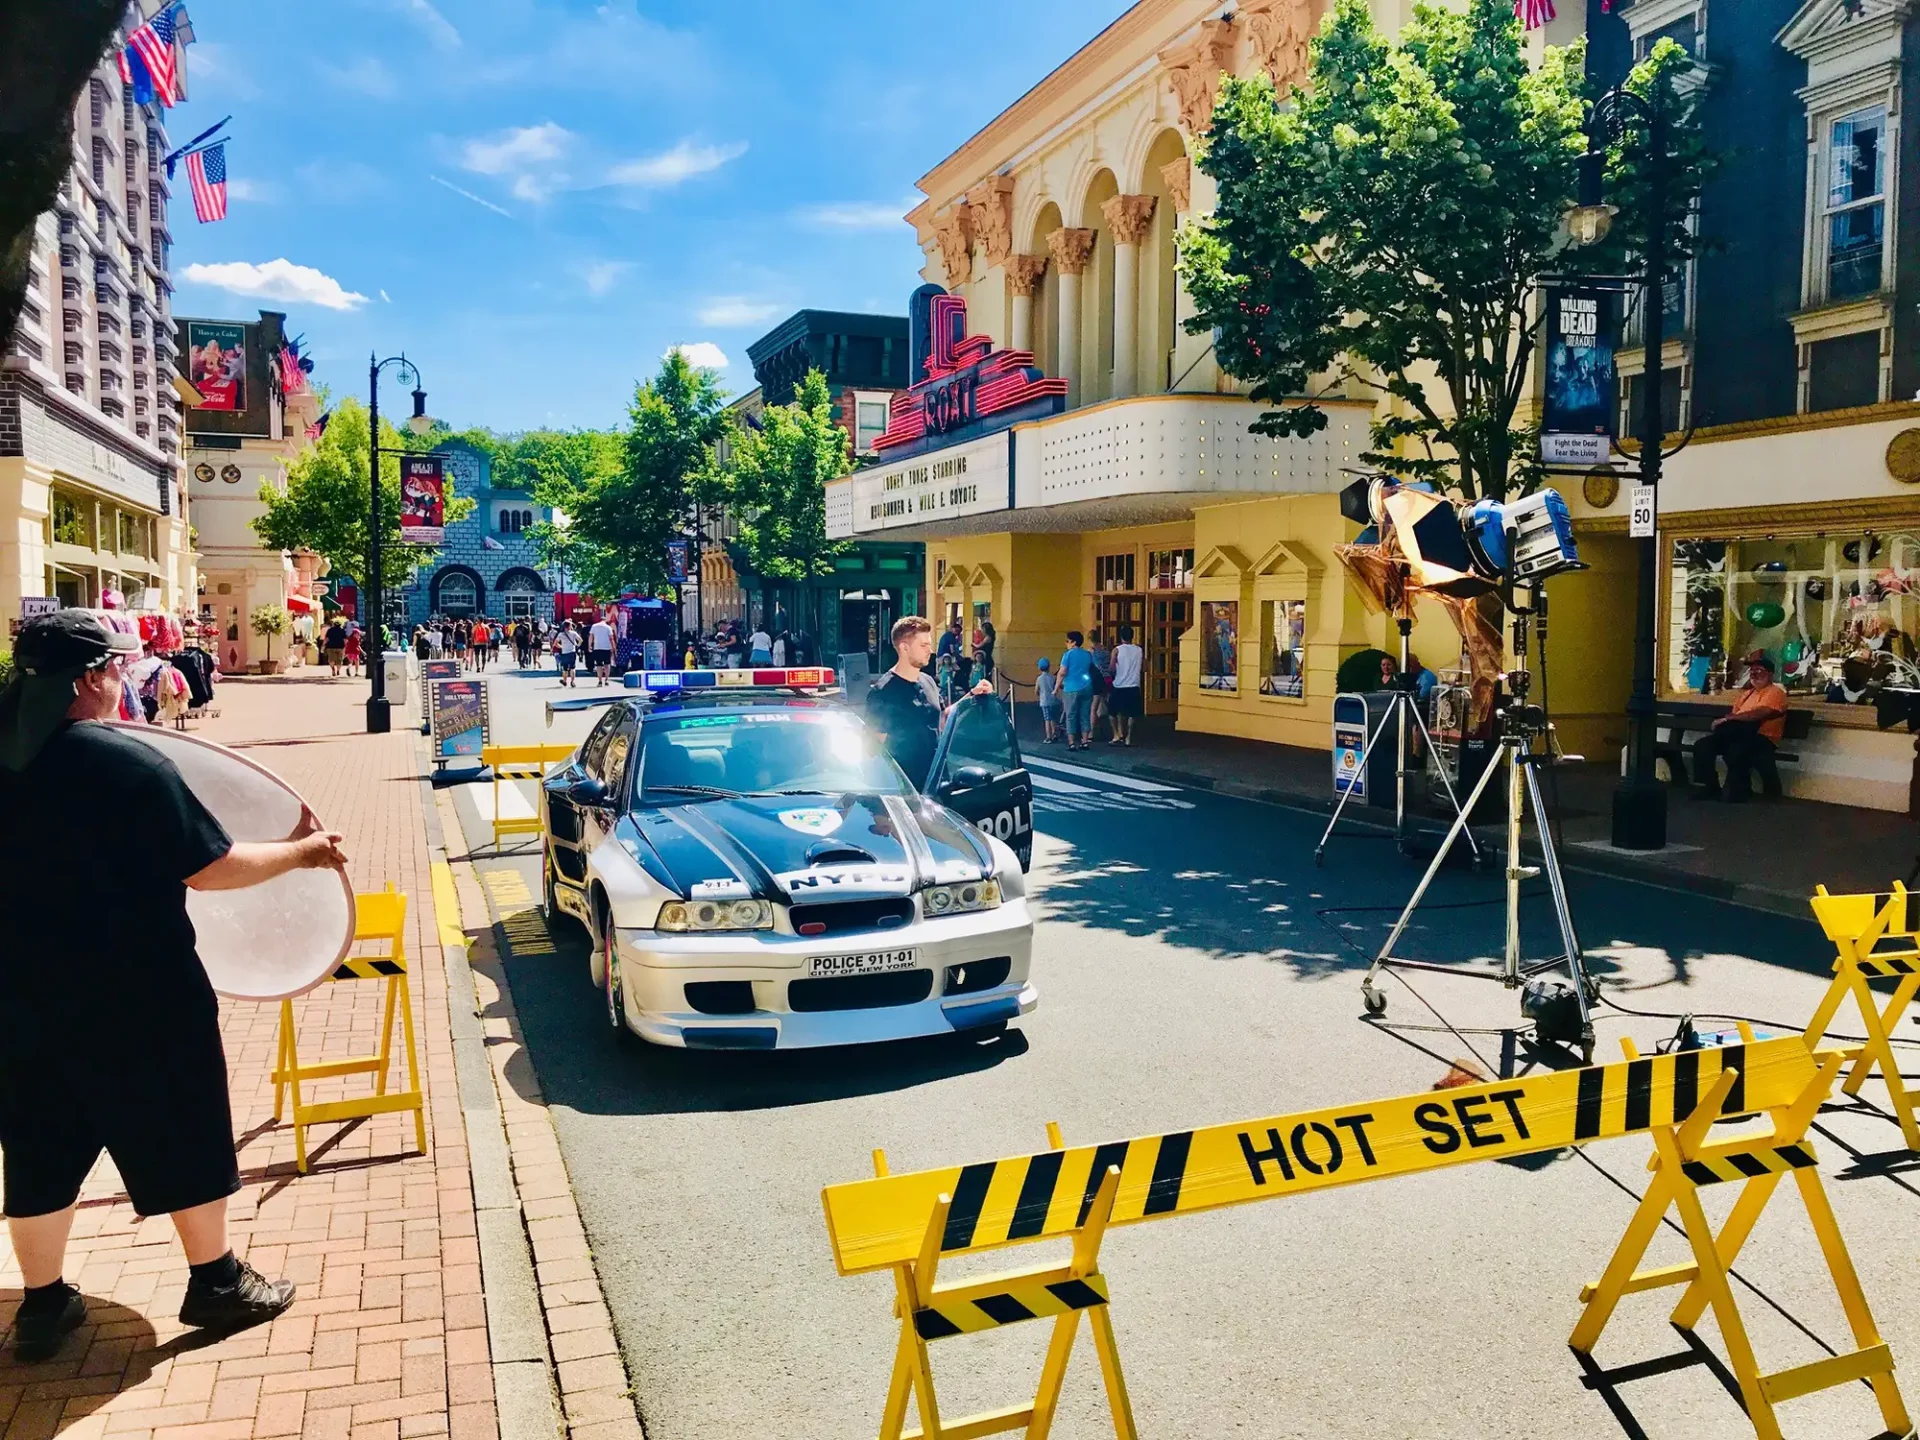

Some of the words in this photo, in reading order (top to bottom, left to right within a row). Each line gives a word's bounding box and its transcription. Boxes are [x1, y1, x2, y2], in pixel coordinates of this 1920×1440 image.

[1560, 298, 1597, 313] WALKING
[1560, 312, 1597, 335] DEAD
[1566, 335, 1596, 348] BREAKOUT
[924, 376, 971, 432] ROXY
[1555, 439, 1570, 448] Fight
[1571, 439, 1581, 447] the
[1569, 449, 1579, 457] the
[1580, 450, 1598, 458] Living
[932, 457, 967, 480] STARRING
[907, 498, 913, 513] &
[919, 493, 935, 511] WILE
[949, 485, 977, 506] COYOTE
[1634, 508, 1650, 524] 50
[444, 693, 476, 701] HOLLYWOOD
[742, 714, 790, 722] TEAM
[813, 956, 863, 970] POLICE
[868, 950, 913, 965] 911-01
[810, 969, 837, 977] CITY
[859, 965, 883, 973] NEW
[886, 961, 915, 970] YORK
[1237, 1113, 1378, 1185] HOT
[1413, 1089, 1531, 1154] SET
